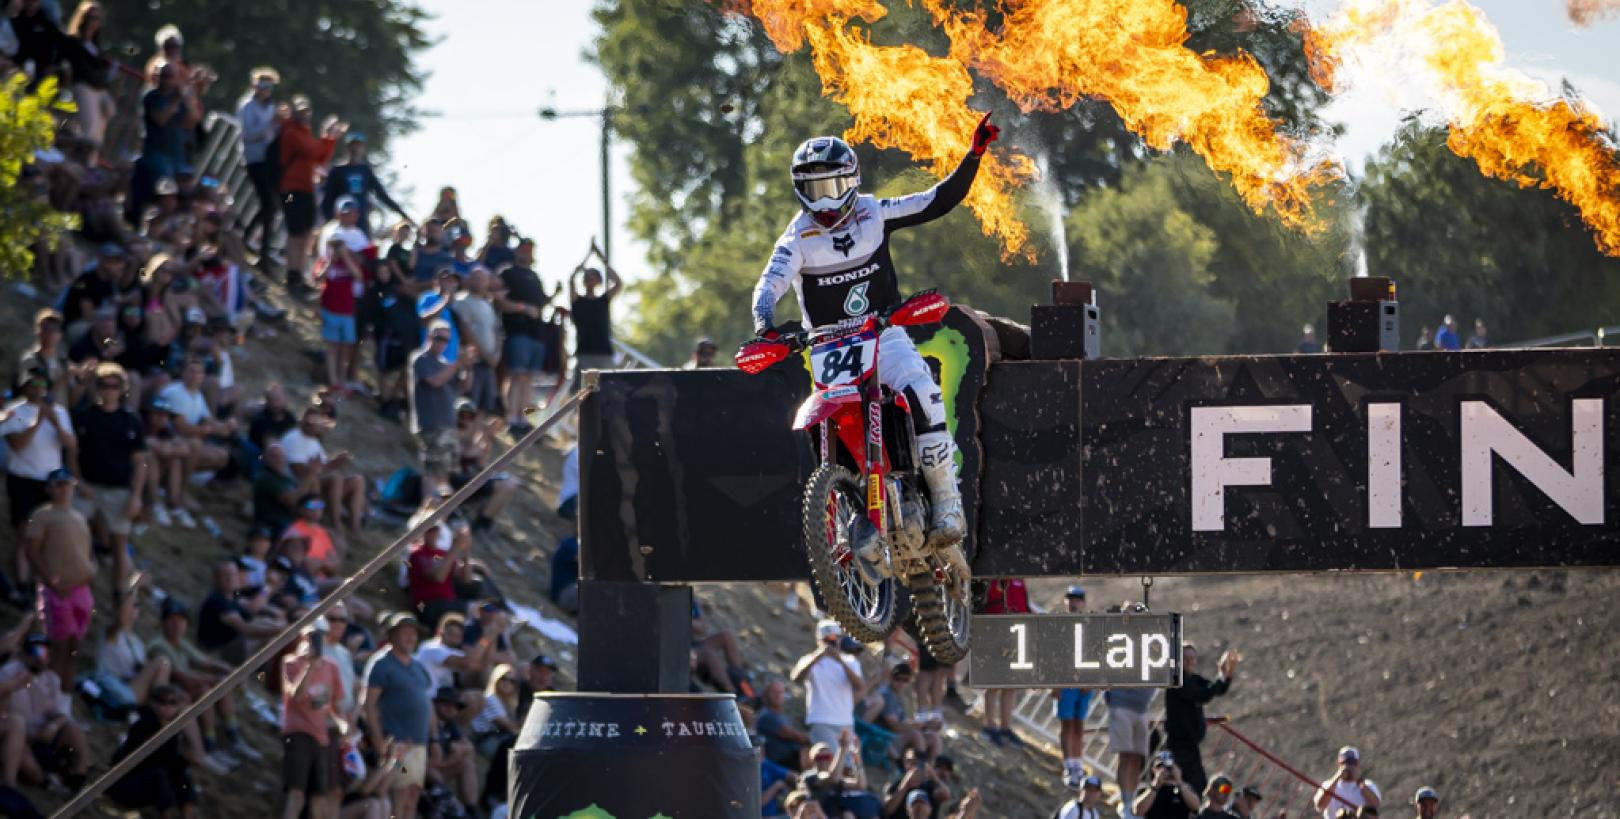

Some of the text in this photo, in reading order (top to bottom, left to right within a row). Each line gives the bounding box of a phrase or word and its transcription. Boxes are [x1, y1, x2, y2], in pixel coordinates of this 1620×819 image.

[817, 263, 880, 286] HONDA
[822, 344, 863, 384] 84
[1191, 398, 1605, 531] FIN
[1009, 623, 1034, 670] 1
